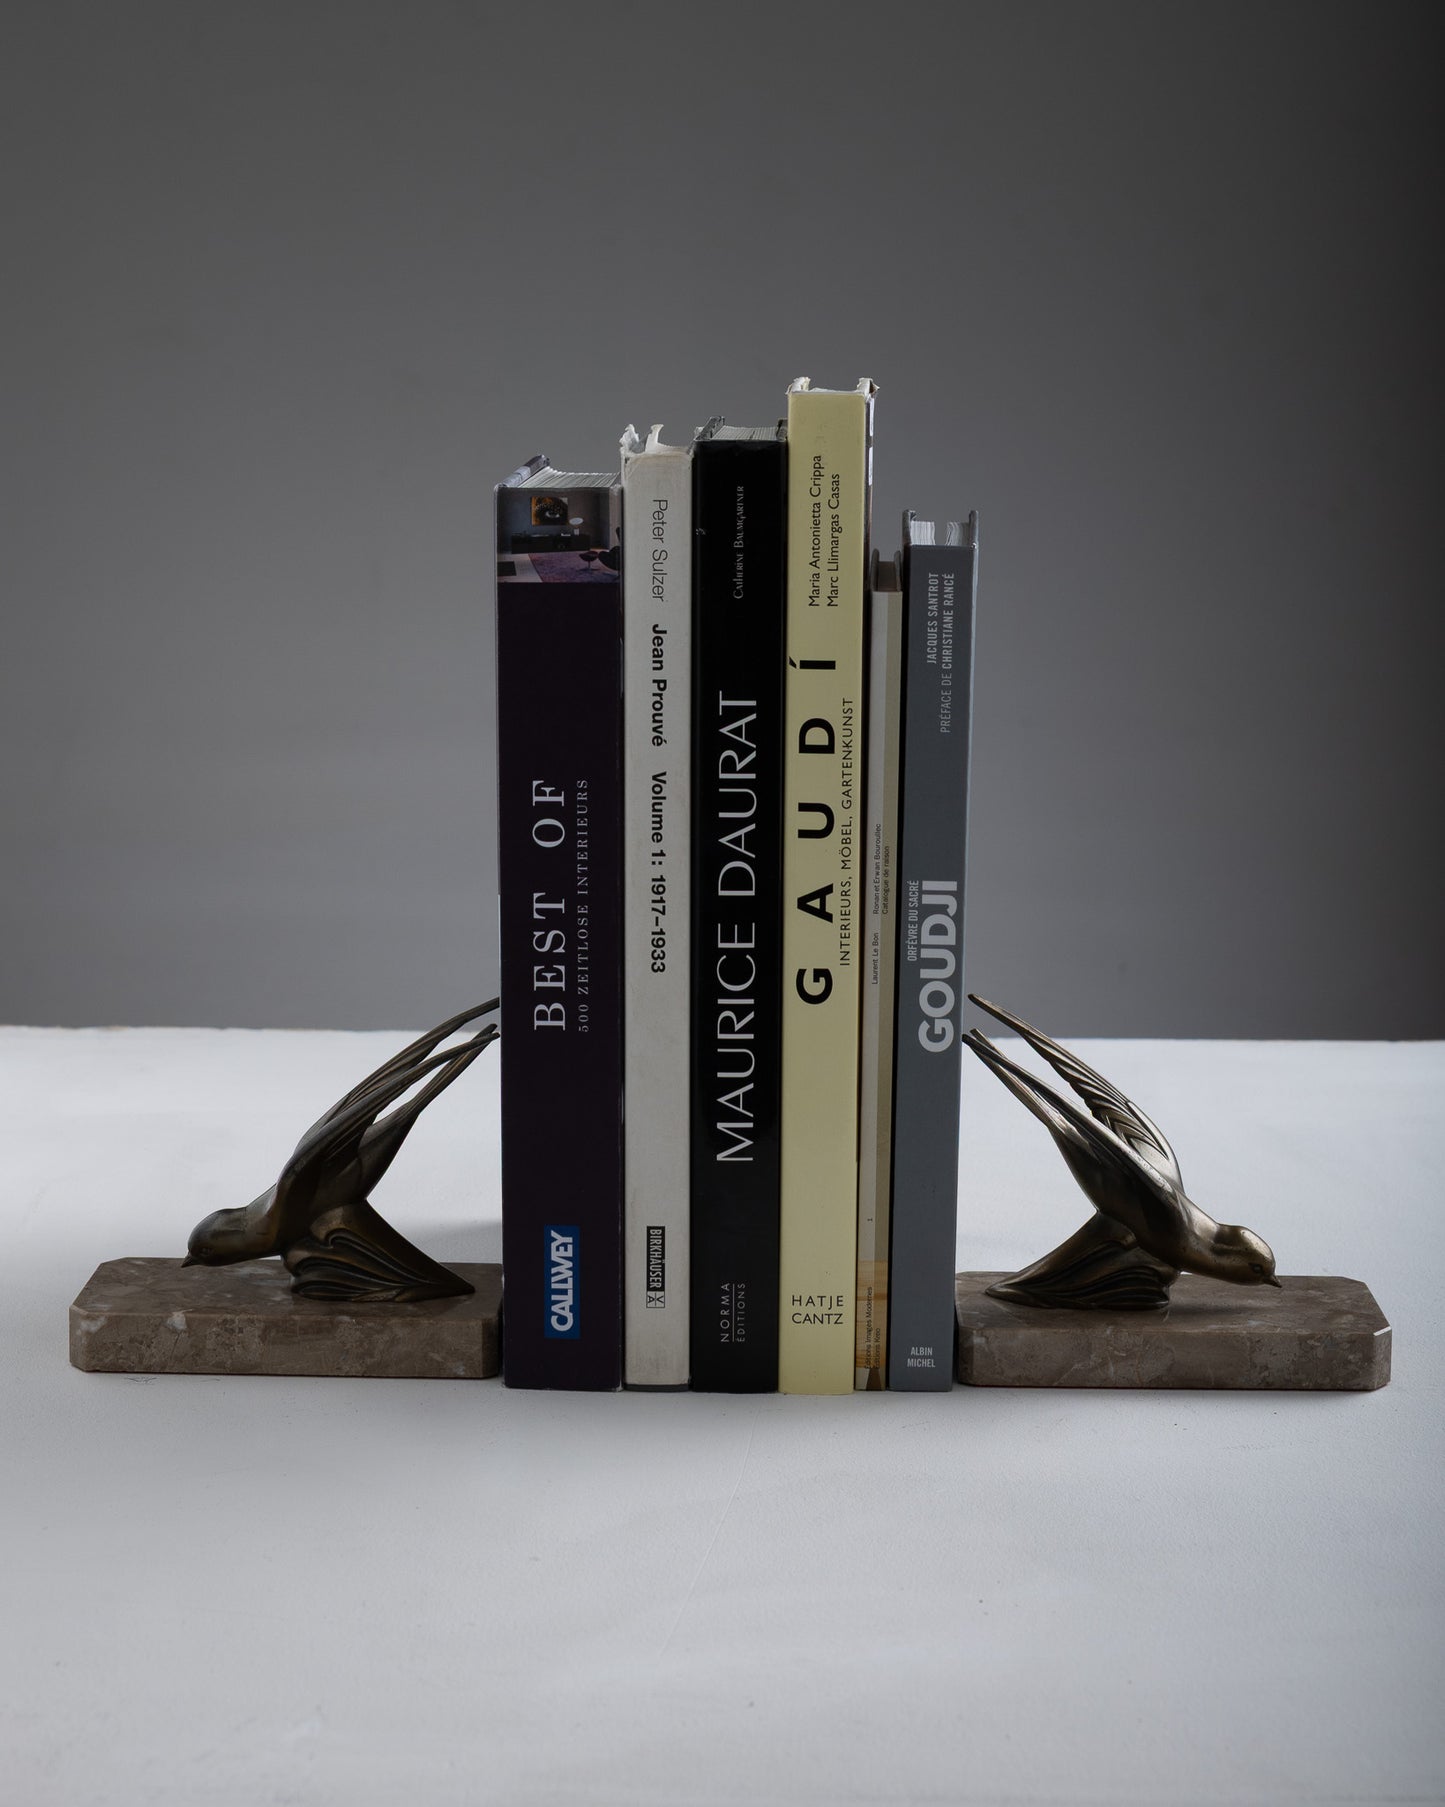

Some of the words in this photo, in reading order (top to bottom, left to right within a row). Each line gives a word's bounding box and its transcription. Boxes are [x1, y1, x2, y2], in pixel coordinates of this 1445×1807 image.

[809, 455, 824, 498] Crippa
[828, 473, 840, 510] Casas
[652, 499, 667, 543] Peter
[809, 502, 821, 569] Antonietta
[828, 514, 842, 572] Llimargas
[652, 549, 667, 602] Sulzer
[809, 572, 821, 607] Maria
[828, 576, 839, 607] Marc
[928, 572, 939, 615] SANTROT
[942, 572, 955, 606] RANCÉ
[652, 624, 667, 671] Jean
[927, 617, 938, 664] JACQUES
[942, 610, 954, 669] CHRISTIANE
[942, 673, 952, 687] DE
[652, 679, 667, 747] Prouvé
[939, 690, 953, 734] PRÉFACE
[841, 697, 853, 810] GARTENKUNST
[532, 779, 565, 848] OF
[651, 771, 666, 842] Volume
[718, 691, 757, 896] DAURAT
[578, 779, 588, 894] INTERIEURS
[651, 849, 666, 866] 1:
[838, 816, 853, 870] MÖBEL,
[883, 869, 889, 877] de
[908, 879, 919, 906] SACRÉ
[839, 876, 852, 965] INTERIEURS,
[882, 880, 890, 914] Catalogue
[908, 907, 918, 921] DU
[533, 892, 566, 1031] BEST
[578, 904, 588, 994] ZEITLOSE
[872, 948, 878, 956] Le
[907, 923, 918, 962] ORFÈVRE
[917, 879, 958, 1052] GOUDJI
[578, 1004, 589, 1032] 500
[716, 922, 754, 1163] MAURICE
[550, 1230, 573, 1331] CALLWEY
[649, 1228, 665, 1289] BIRKHÄUSER
[720, 1283, 730, 1342] NORMA
[736, 1283, 745, 1342] ÉDITIONS
[792, 1294, 844, 1309] HATJE
[792, 1312, 844, 1325] CANTZ
[907, 1358, 936, 1368] MICHEL
[910, 1347, 933, 1356] ALBIN
